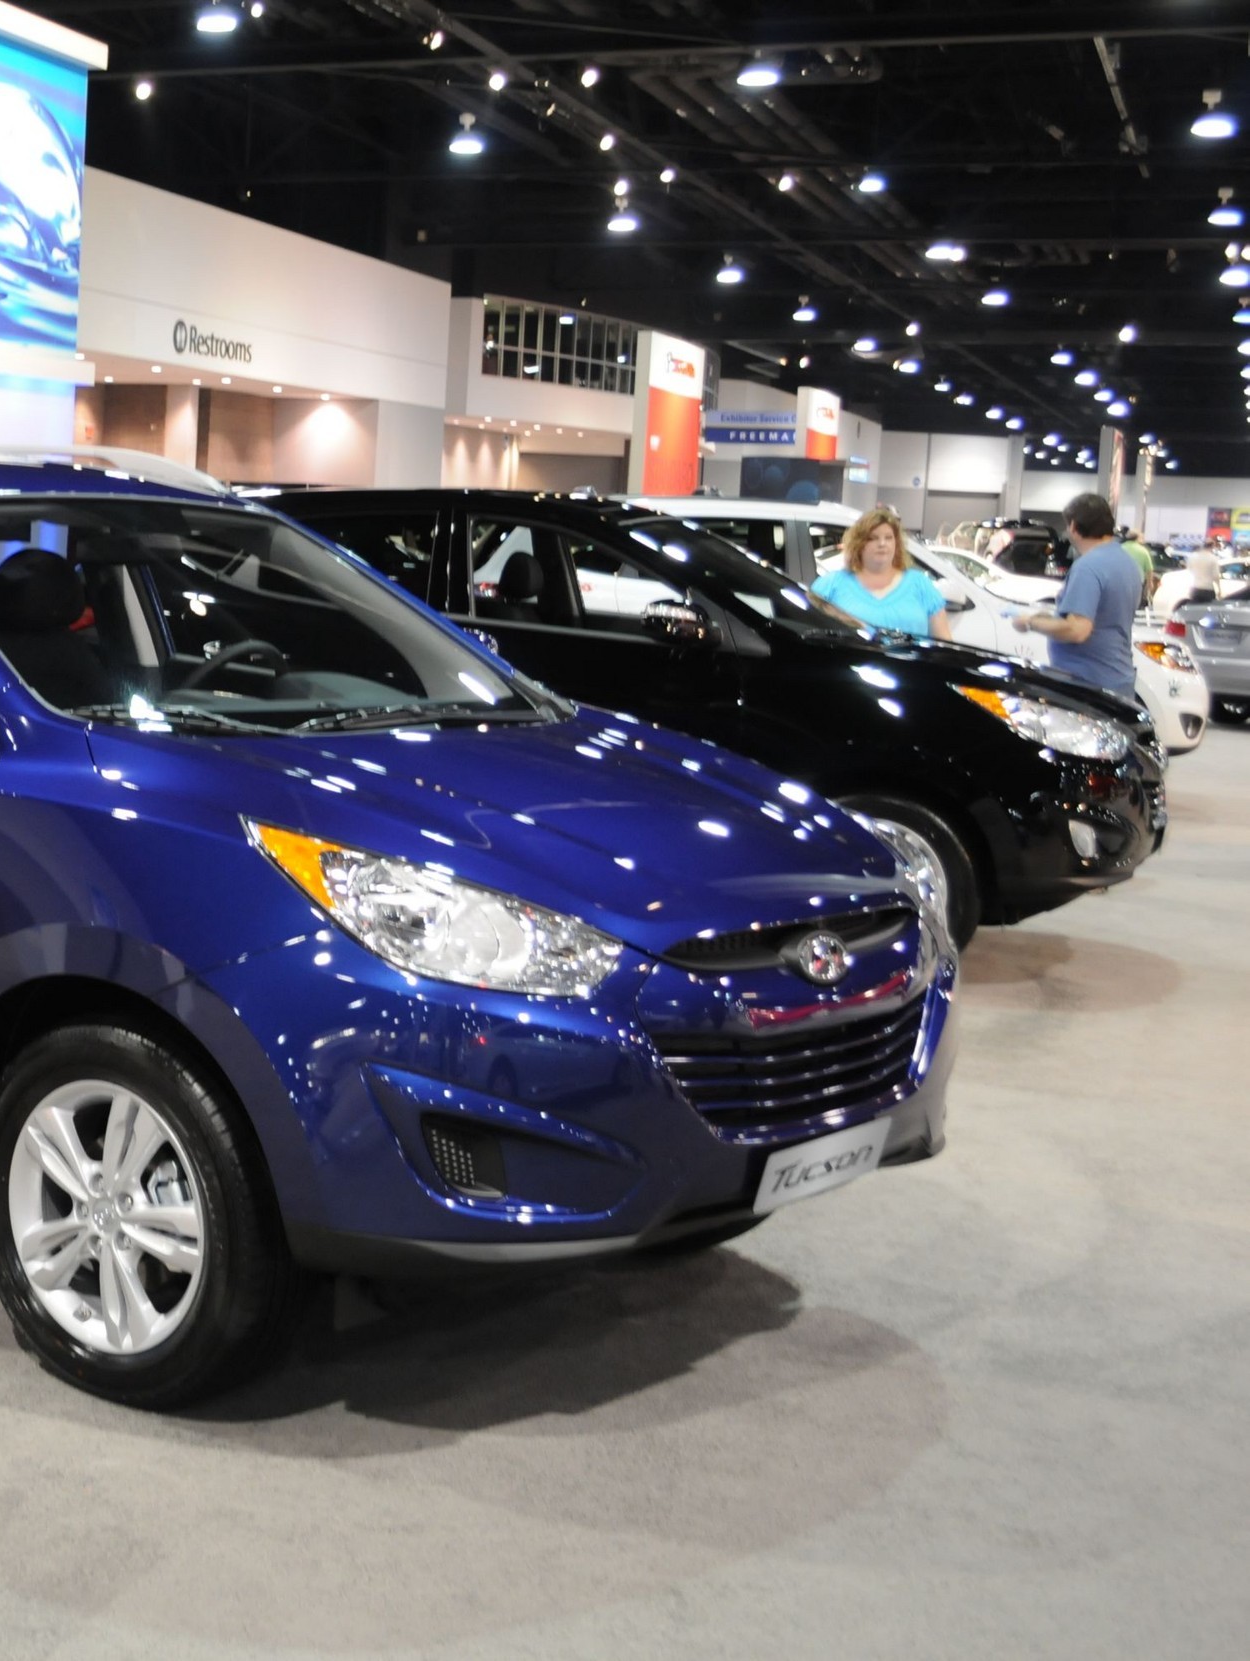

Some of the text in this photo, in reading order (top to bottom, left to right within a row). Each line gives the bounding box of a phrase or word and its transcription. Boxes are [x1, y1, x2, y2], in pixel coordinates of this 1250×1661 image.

[189, 324, 252, 364] Restrooms
[729, 431, 796, 442] FREEMA
[771, 1144, 873, 1194] Tucson
